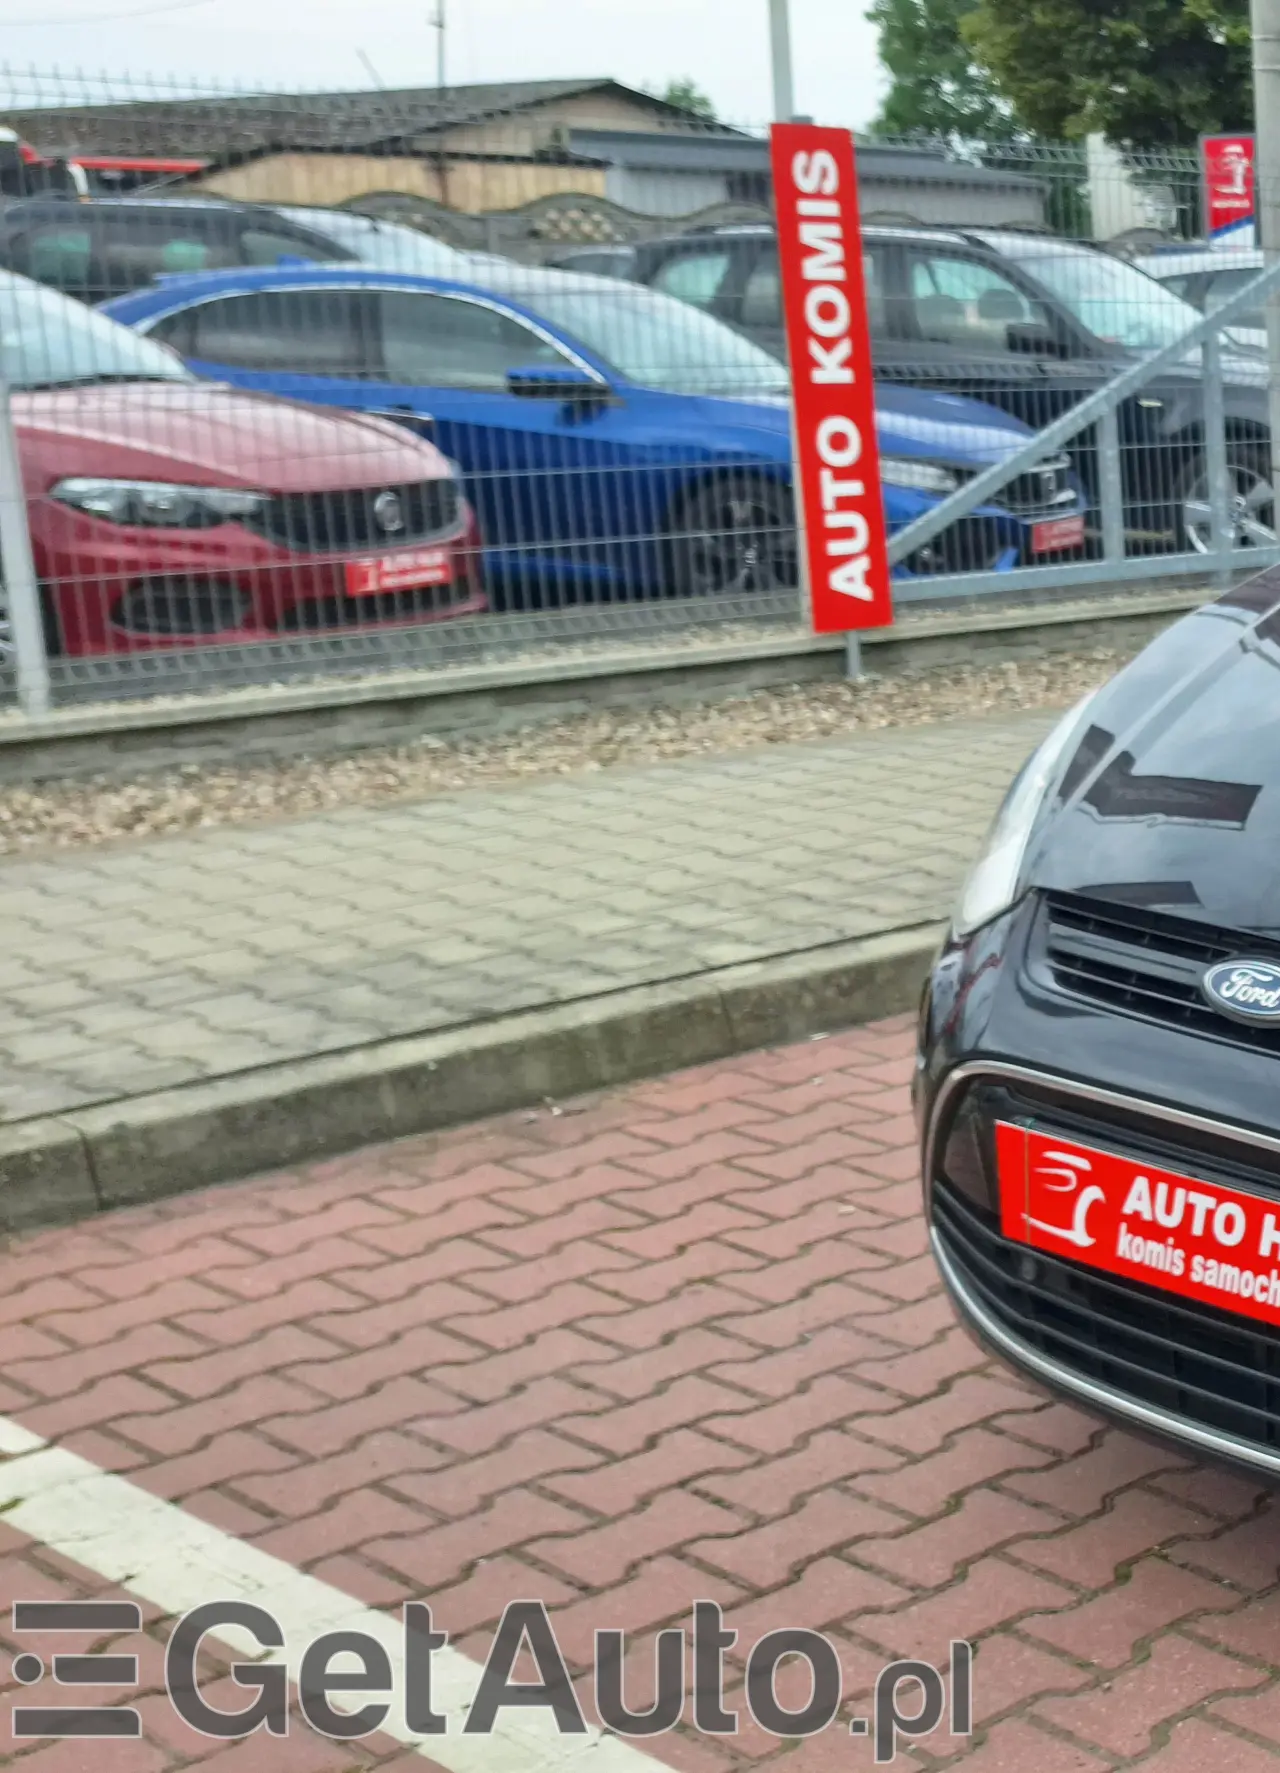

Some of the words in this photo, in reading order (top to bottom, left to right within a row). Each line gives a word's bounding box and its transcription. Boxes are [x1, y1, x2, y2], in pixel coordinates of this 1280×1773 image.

[791, 149, 856, 384] KOMIS
[815, 414, 874, 602] AUTO
[1115, 1222, 1186, 1276] komis
[1122, 1175, 1247, 1247] AUTO
